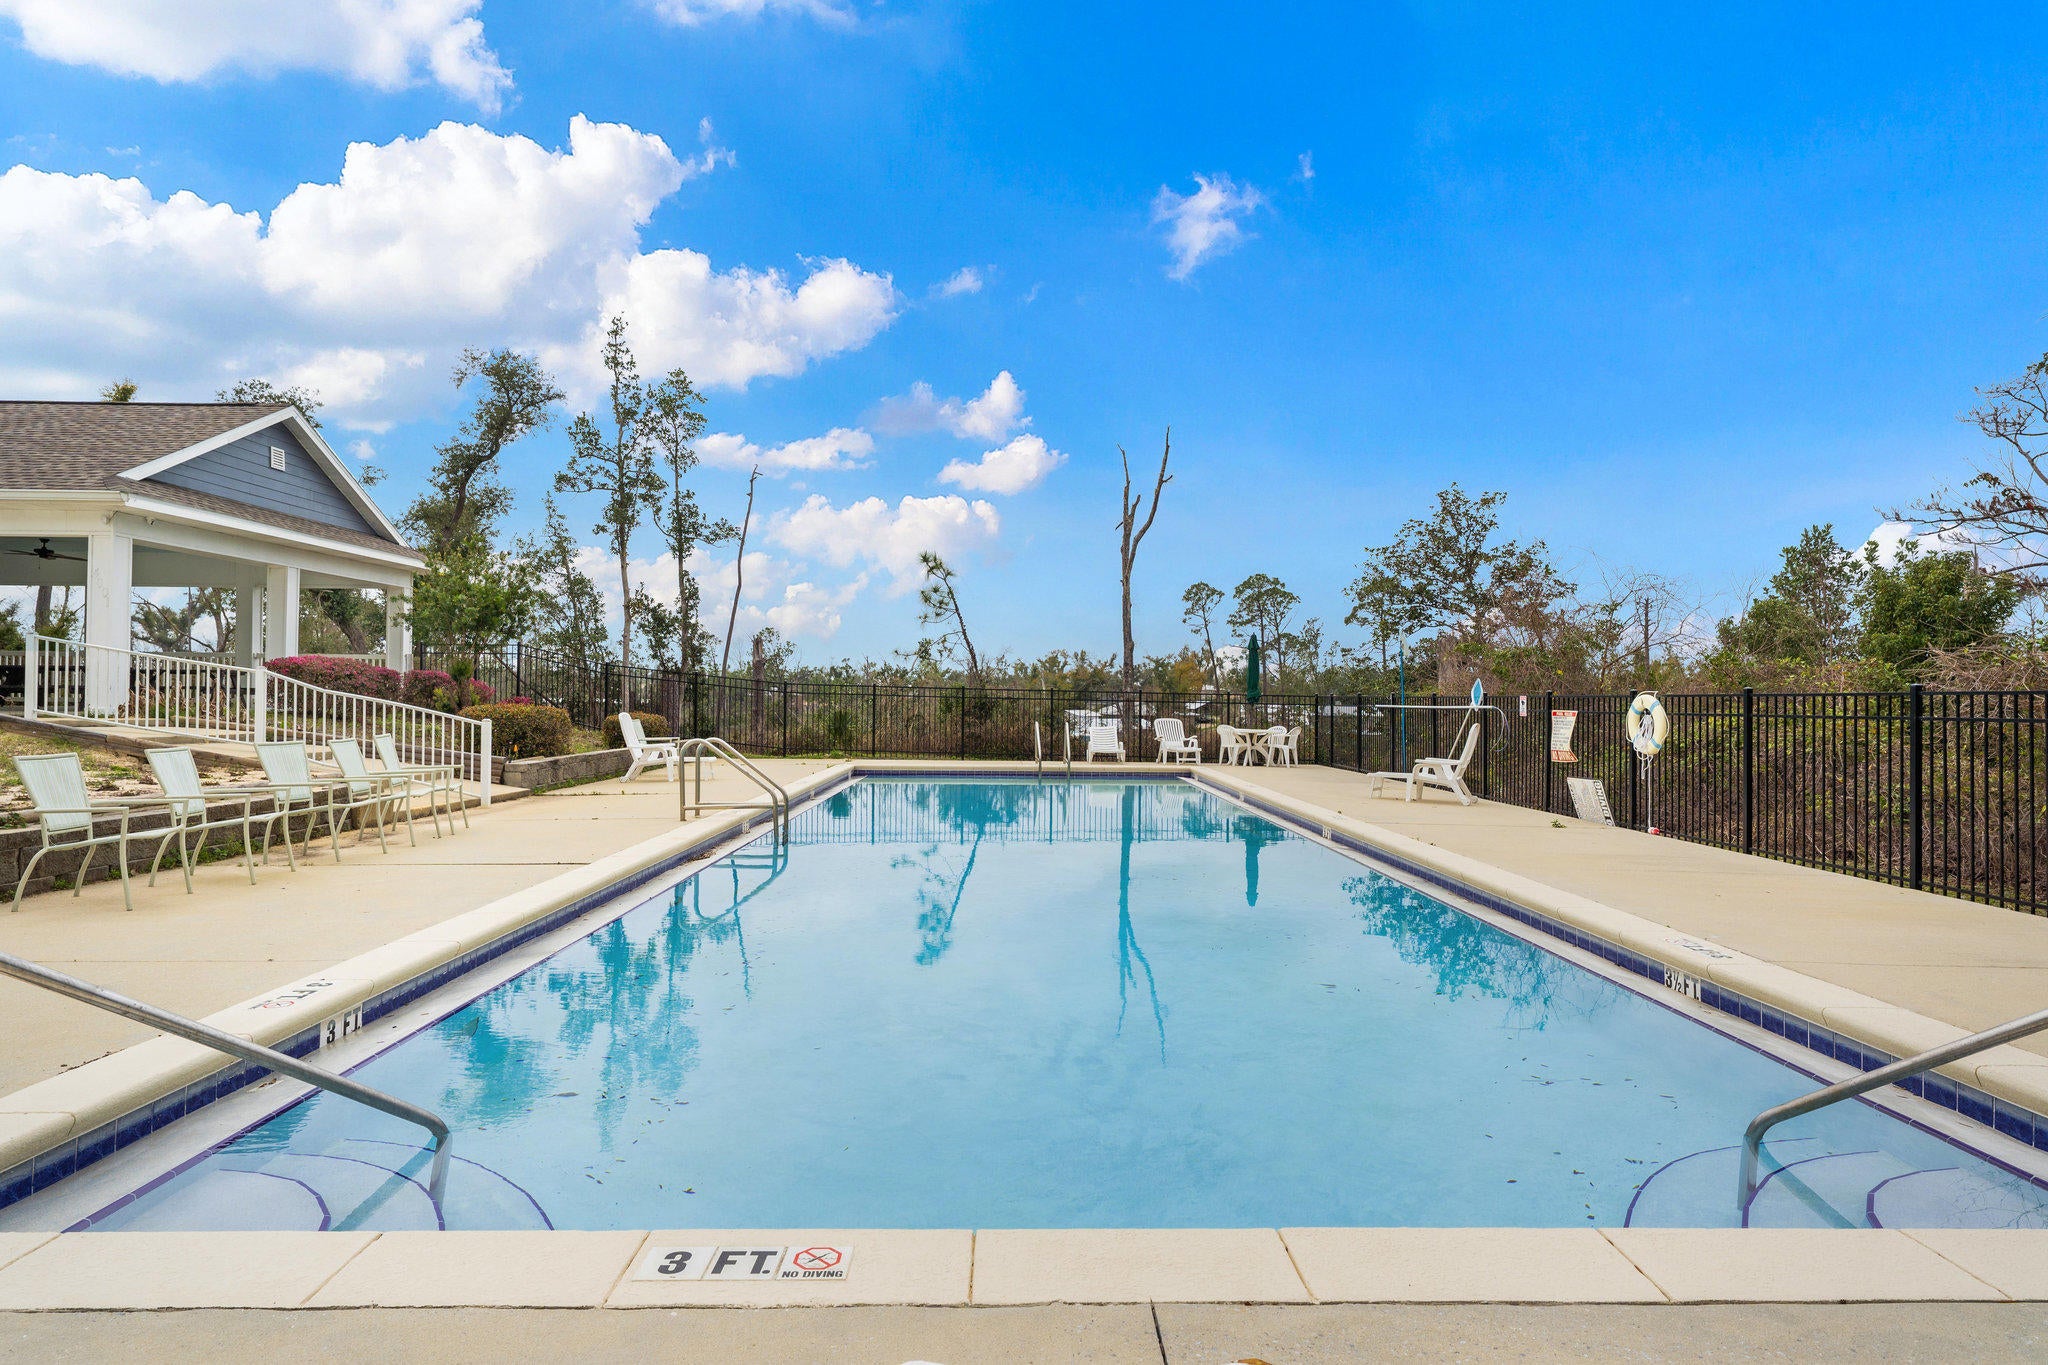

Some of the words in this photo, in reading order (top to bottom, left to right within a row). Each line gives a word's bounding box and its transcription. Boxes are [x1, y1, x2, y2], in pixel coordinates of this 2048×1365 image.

[326, 1019, 336, 1044] 3
[657, 1250, 693, 1274] 3
[711, 1250, 778, 1274] FT.
[781, 1270, 798, 1278] NO
[802, 1270, 843, 1278] DIVING
